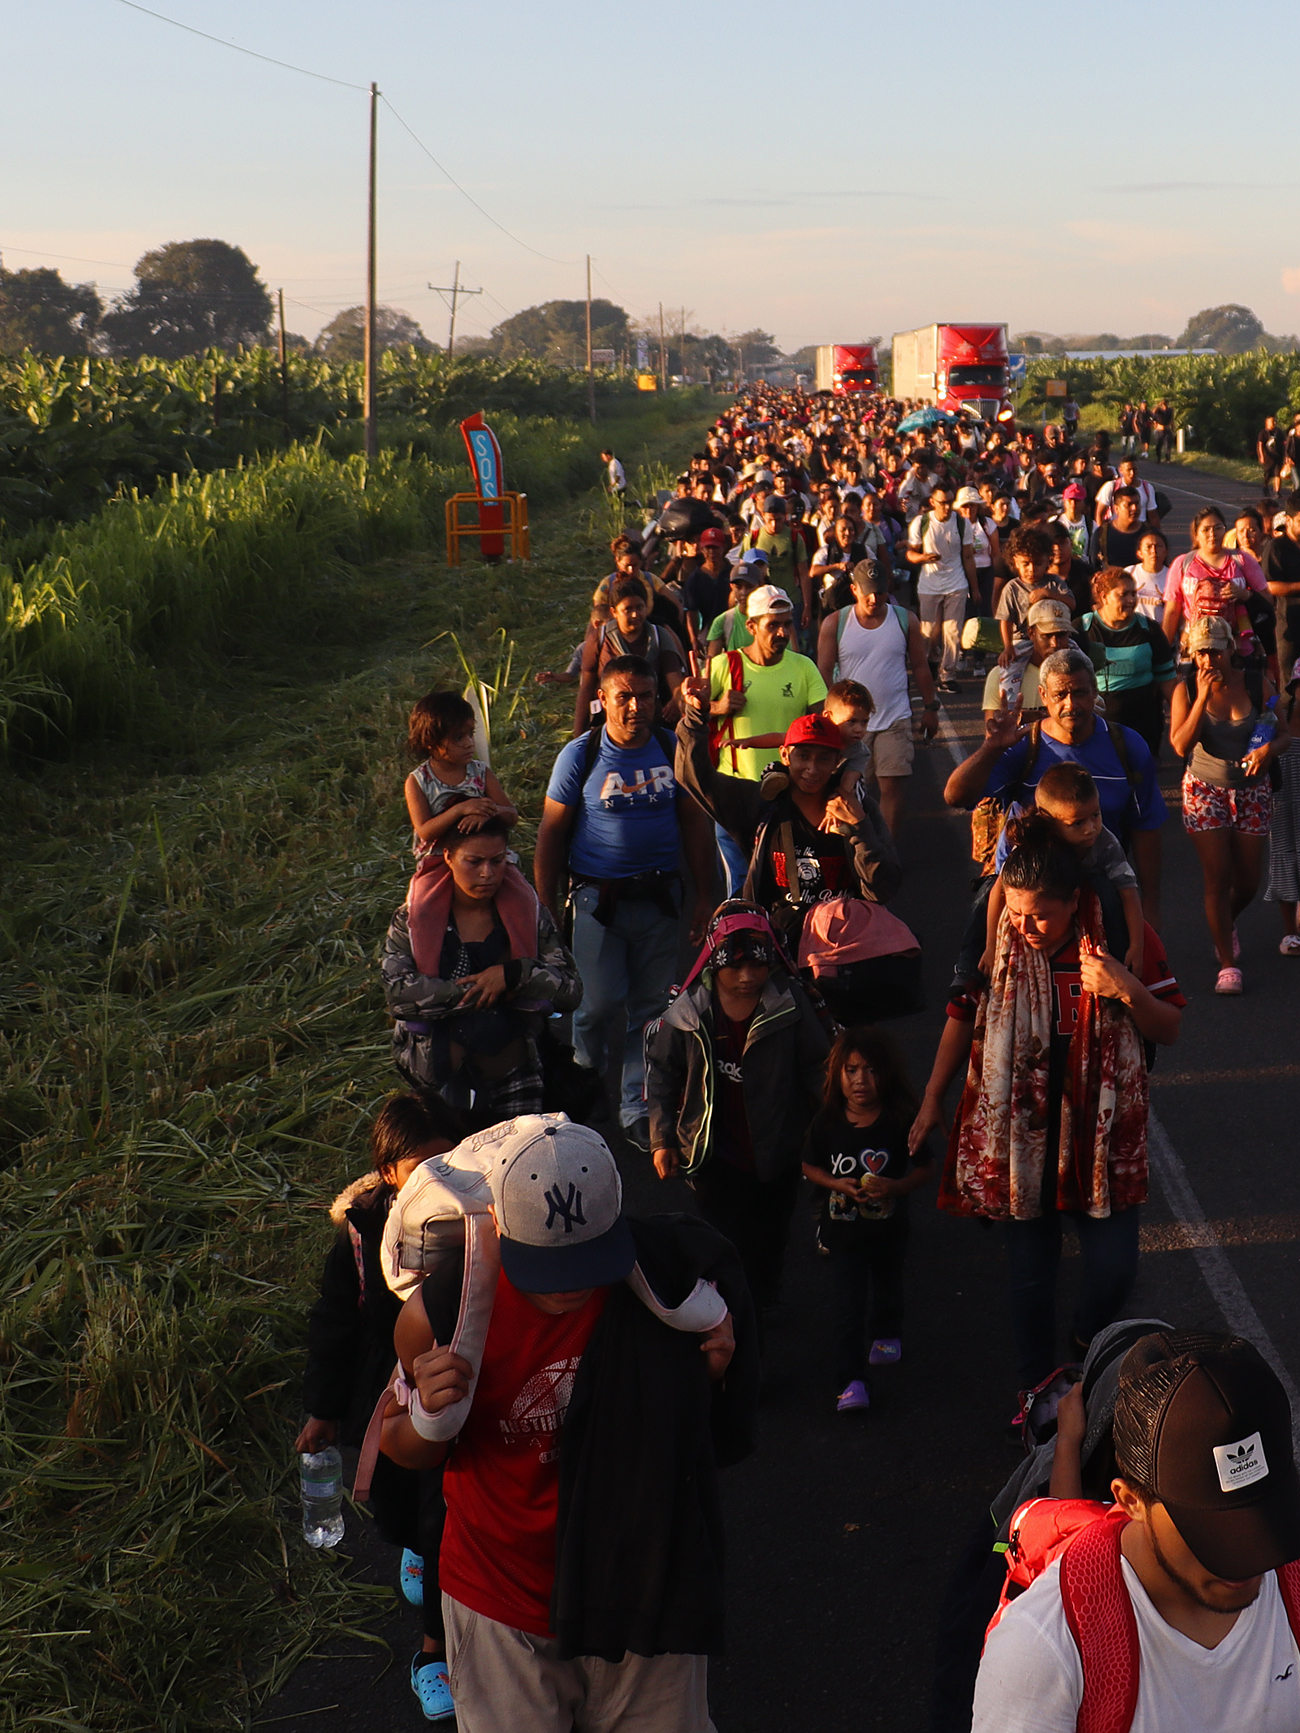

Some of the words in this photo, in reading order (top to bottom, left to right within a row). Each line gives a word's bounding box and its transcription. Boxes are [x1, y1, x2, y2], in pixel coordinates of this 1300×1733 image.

[475, 434, 498, 505] SOS
[599, 765, 675, 799] AIR
[831, 1152, 857, 1175] YO
[543, 1181, 588, 1233] NY
[1229, 1459, 1259, 1475] adidas
